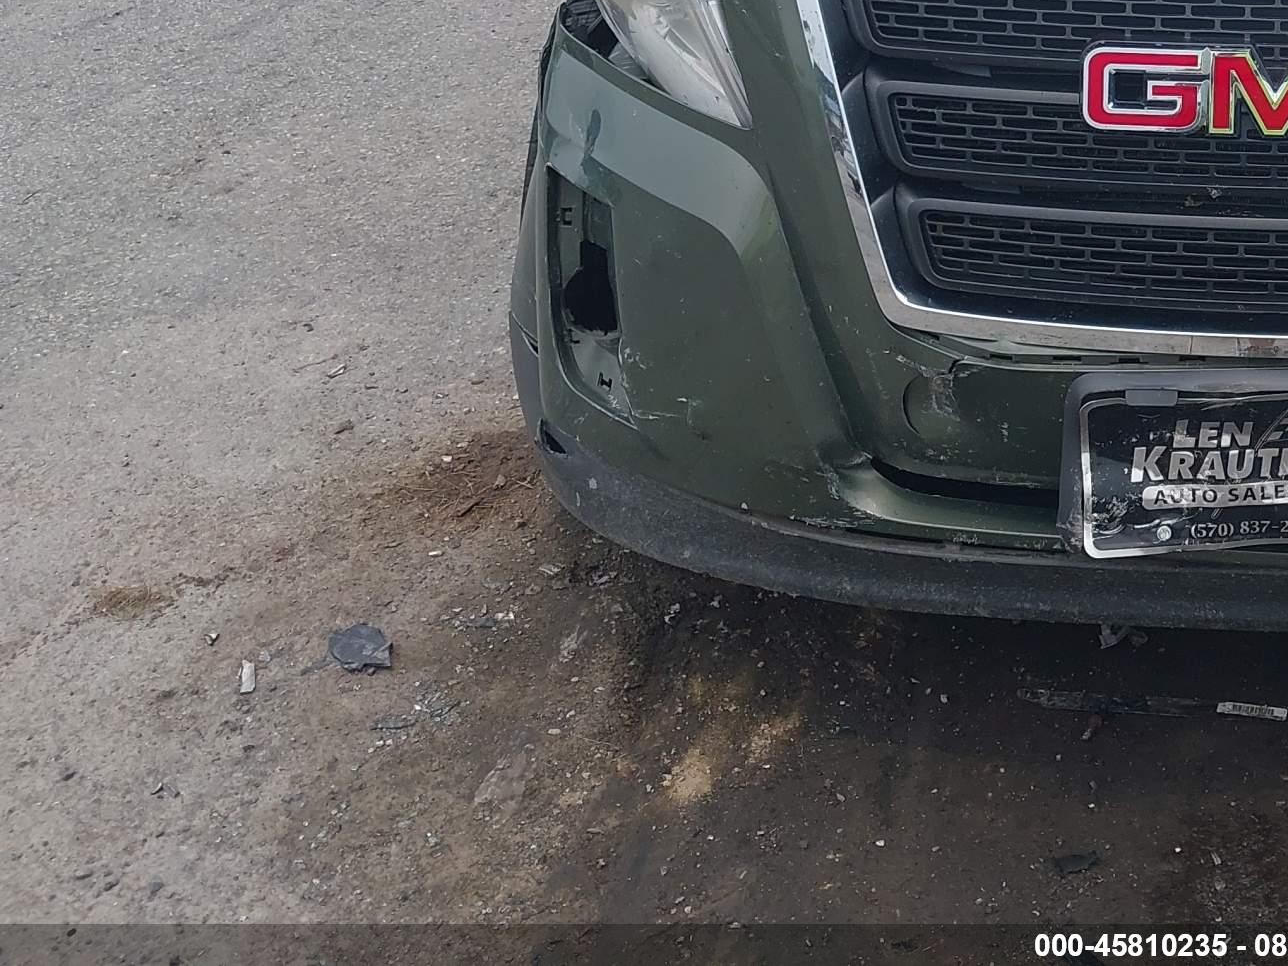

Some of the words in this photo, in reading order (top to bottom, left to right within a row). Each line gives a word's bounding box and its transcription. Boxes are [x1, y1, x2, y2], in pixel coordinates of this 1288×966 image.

[1173, 419, 1253, 449] LEN
[1153, 487, 1218, 507] AUTO
[1190, 520, 1234, 539] (570)
